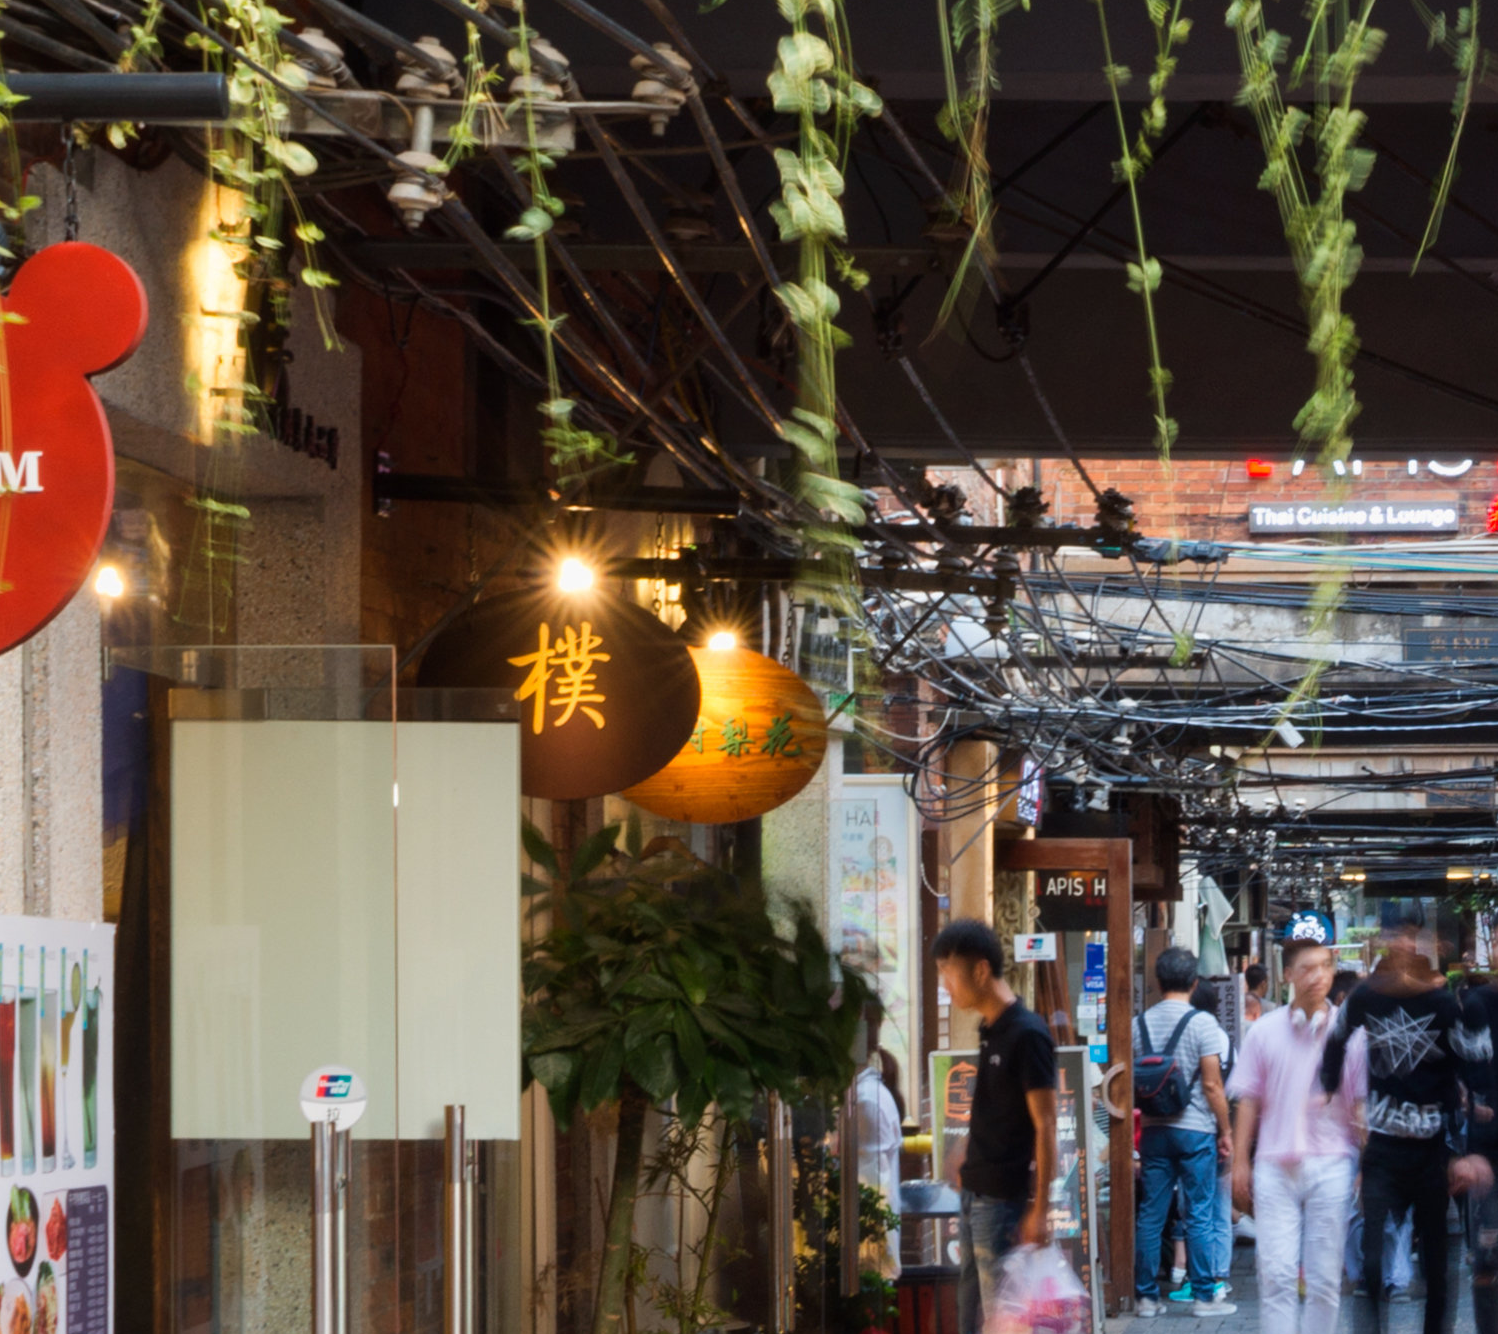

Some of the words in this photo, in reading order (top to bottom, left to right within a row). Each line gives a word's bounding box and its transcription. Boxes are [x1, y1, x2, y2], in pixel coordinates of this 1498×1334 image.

[1252, 506, 1295, 527] Thai
[1296, 505, 1368, 526] Cuisine
[1368, 505, 1385, 524] &
[1386, 506, 1456, 527] Lounge
[1452, 636, 1491, 650] EXIT
[1225, 985, 1236, 1032] SCENTS
